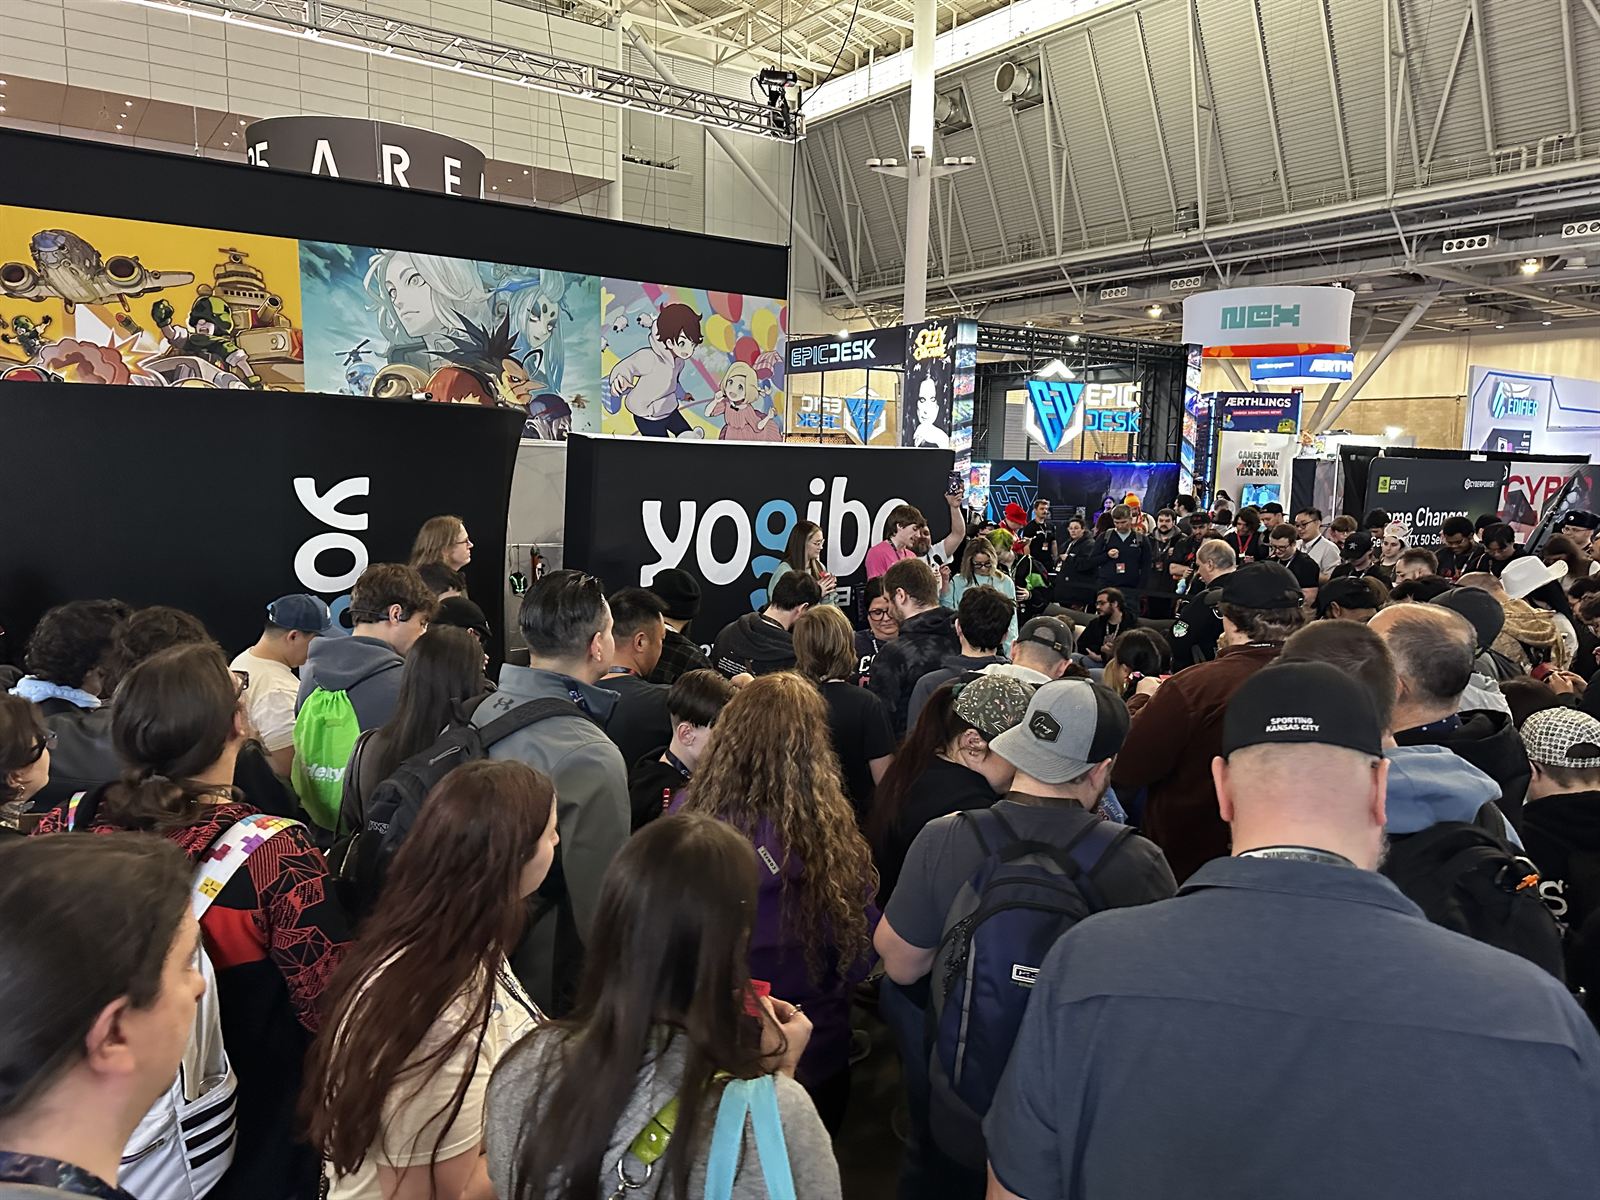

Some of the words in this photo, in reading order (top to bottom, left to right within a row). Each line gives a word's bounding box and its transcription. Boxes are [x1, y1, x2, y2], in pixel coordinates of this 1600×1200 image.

[1086, 383, 1142, 407] EPIC
[1225, 397, 1291, 408] ÆRTHLINGS
[1508, 398, 1539, 417] EDIFIER
[1084, 409, 1142, 432] DESK
[1238, 451, 1262, 460] GAMES
[1263, 452, 1280, 460] THAT
[1241, 460, 1261, 468] MOVE
[1236, 468, 1279, 477] YEAR-ROUND.
[1420, 533, 1430, 546] 50
[1270, 716, 1313, 725] SPORTING
[1265, 724, 1300, 732] KANSAS
[1301, 724, 1320, 732] CITY
